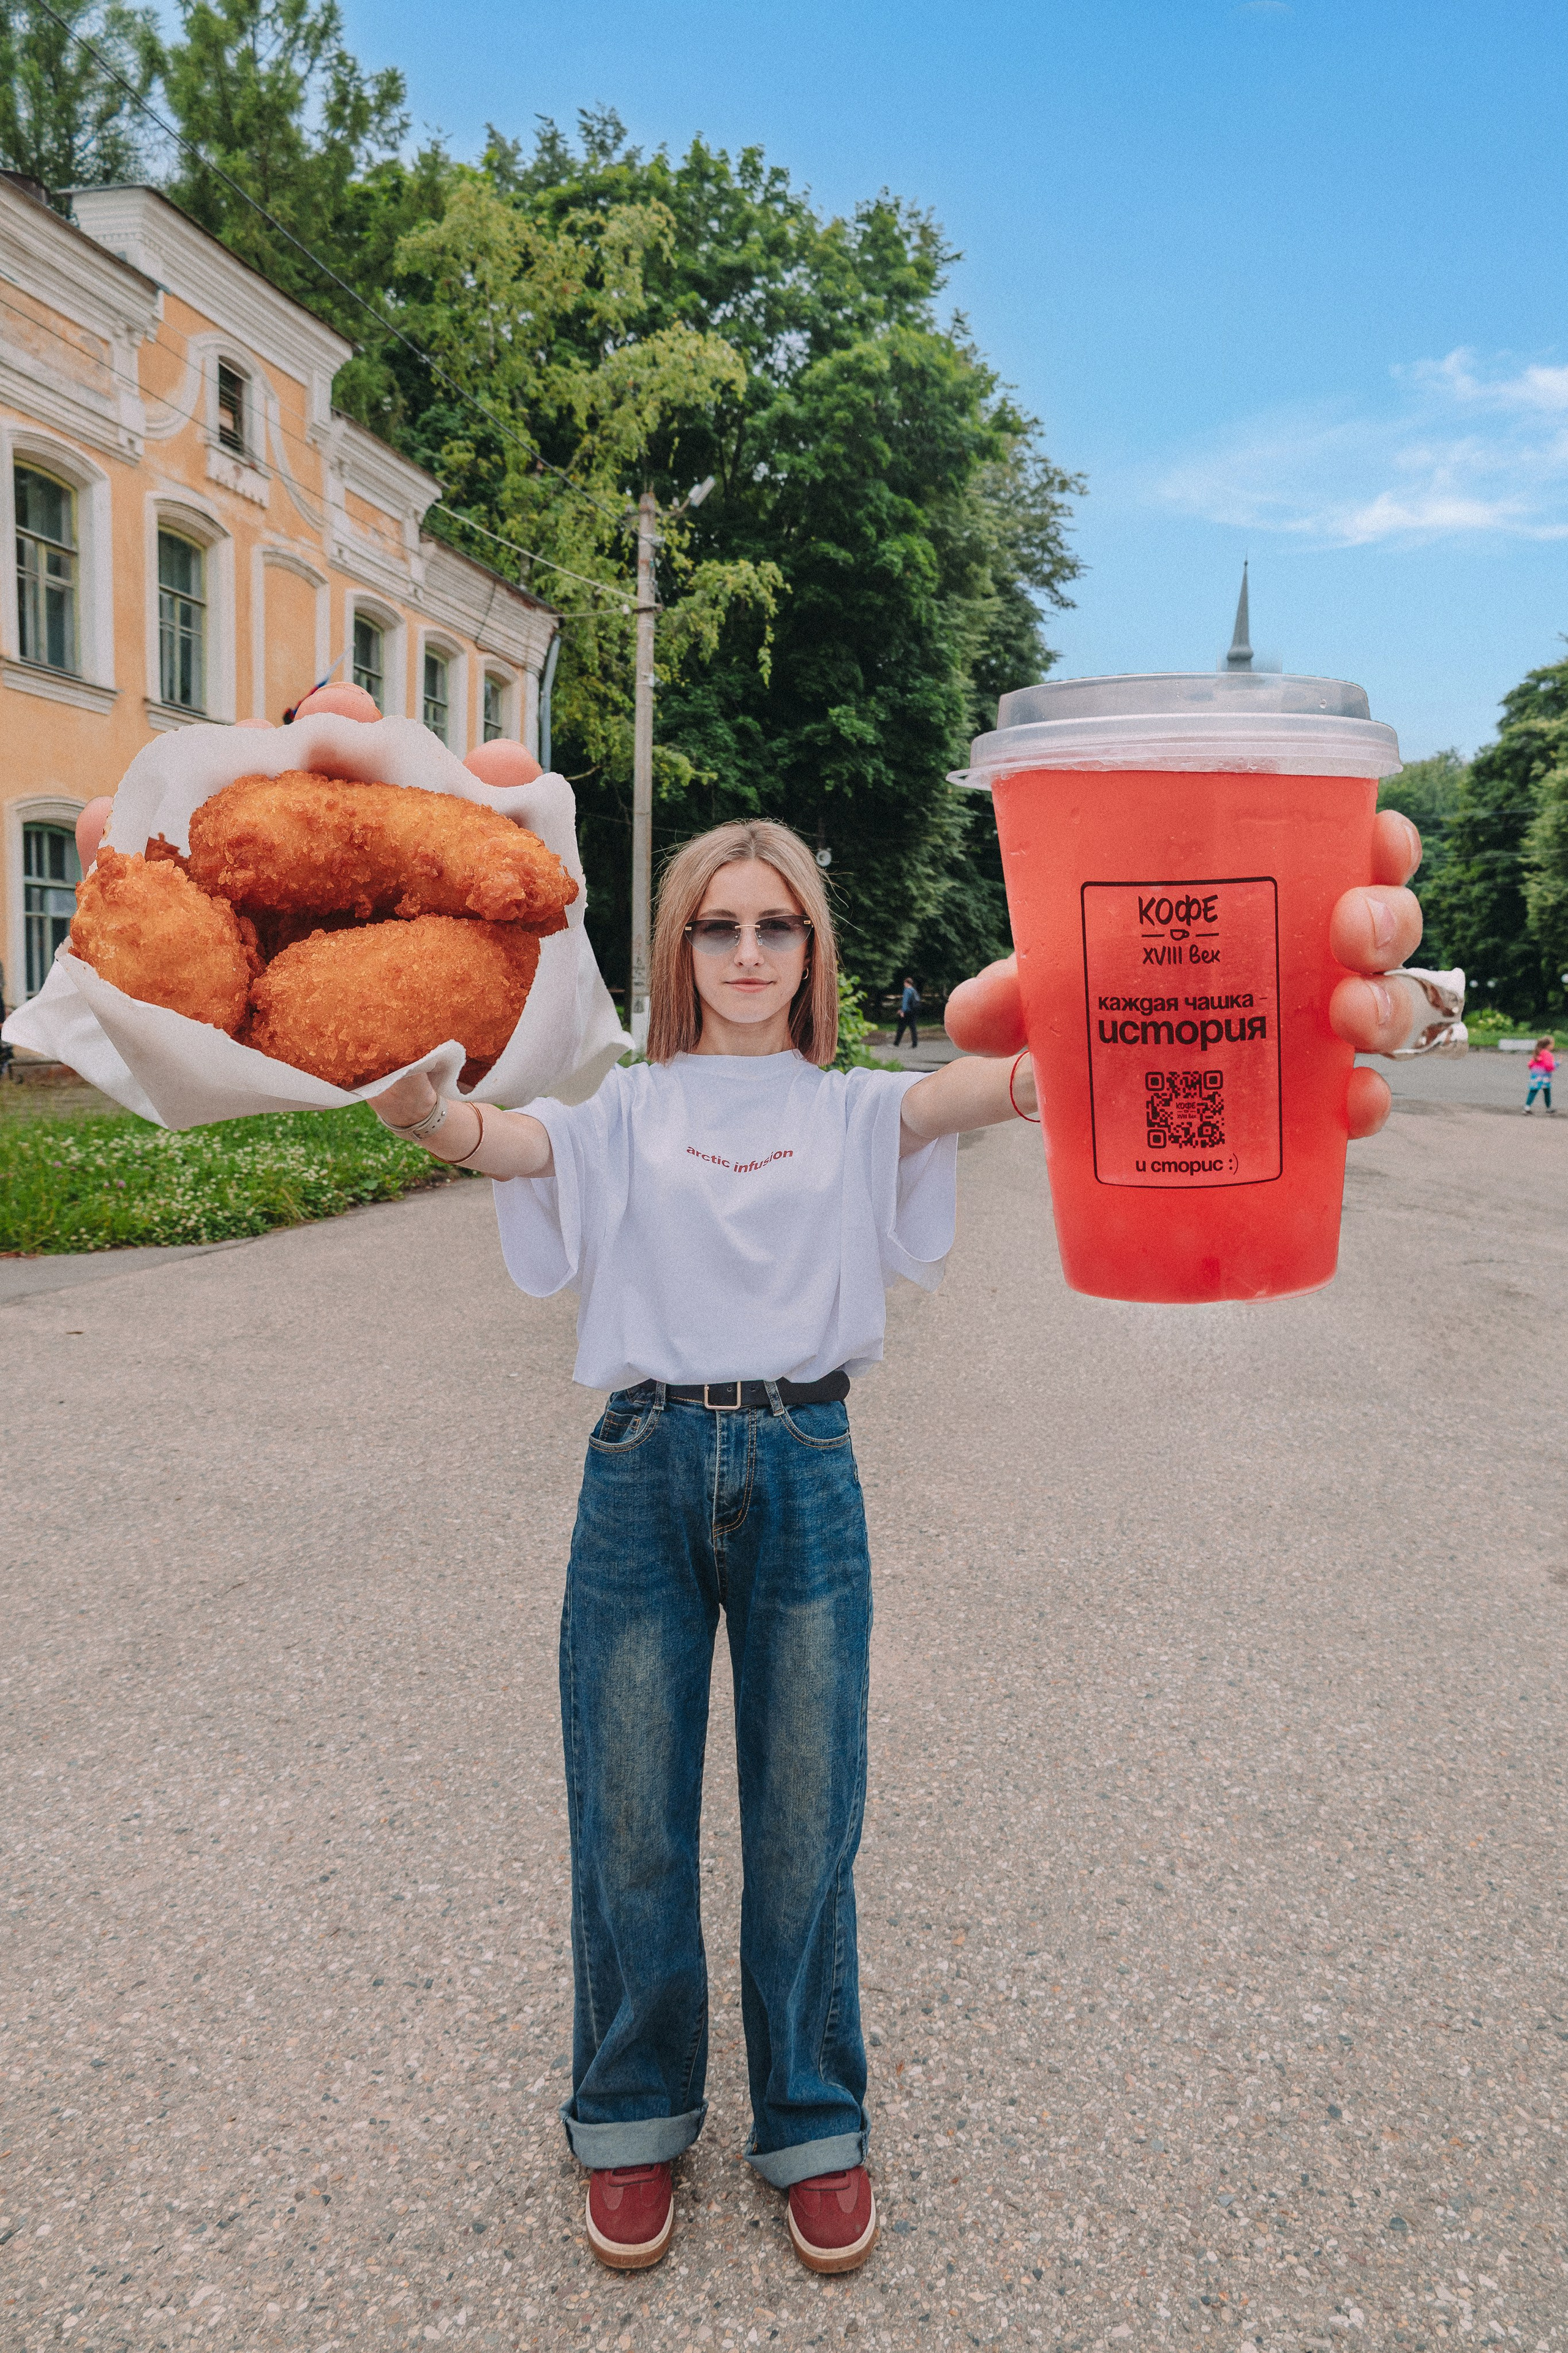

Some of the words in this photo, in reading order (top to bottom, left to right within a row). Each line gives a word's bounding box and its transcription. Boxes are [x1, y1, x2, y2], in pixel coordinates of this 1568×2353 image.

[1139, 894, 1219, 926] КОФЕ
[1142, 946, 1182, 966] XVIII
[1098, 996, 1179, 1016] каждая
[1185, 993, 1254, 1011] чашка
[1098, 1015, 1267, 1051] история
[687, 1146, 731, 1168] arctic
[734, 1149, 794, 1173] infusion
[1136, 1160, 1147, 1172] и
[1151, 1160, 1224, 1176] сторис
